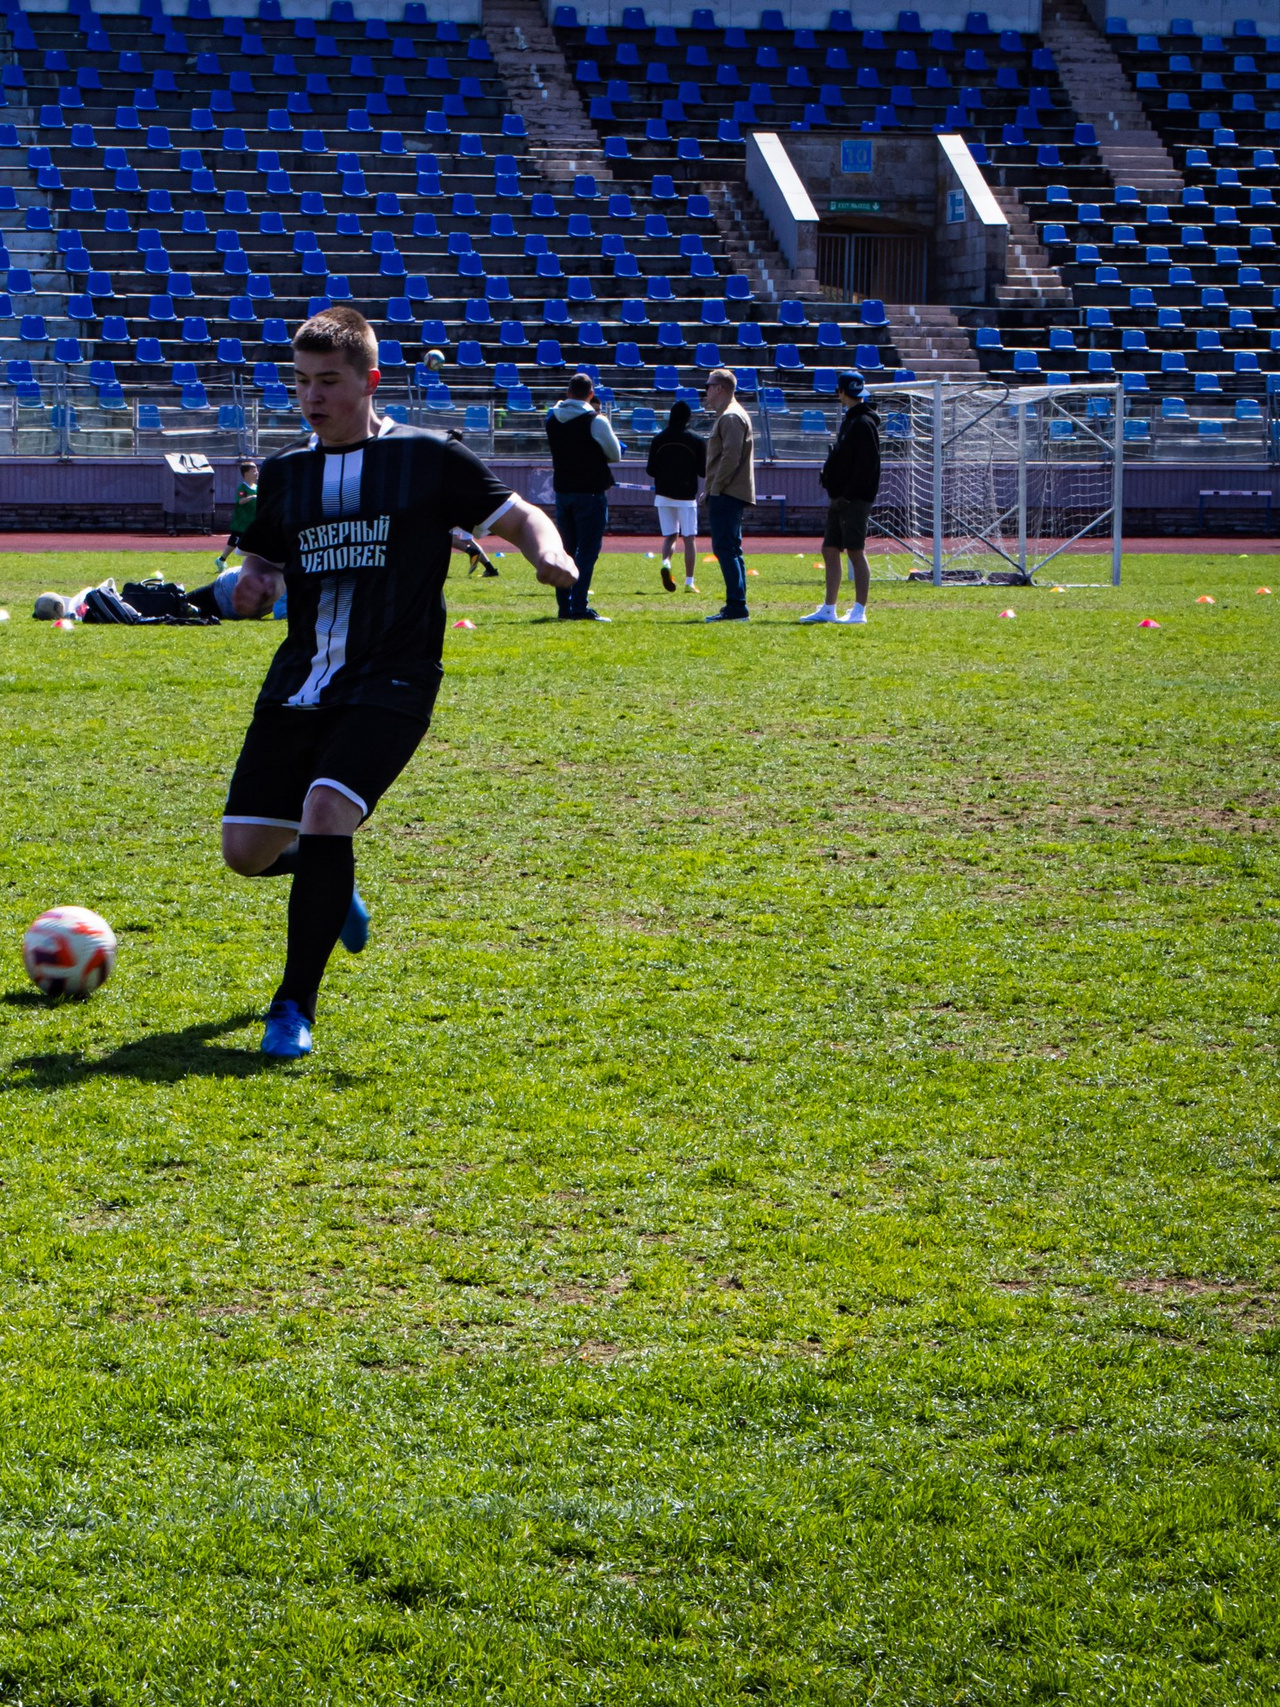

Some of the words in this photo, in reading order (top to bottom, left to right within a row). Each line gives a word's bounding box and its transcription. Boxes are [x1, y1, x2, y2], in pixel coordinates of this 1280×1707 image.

[846, 148, 868, 164] 10
[298, 515, 390, 552] СЕВЕРНЫЙ
[301, 545, 387, 573] ЧЕЛОВЕК
